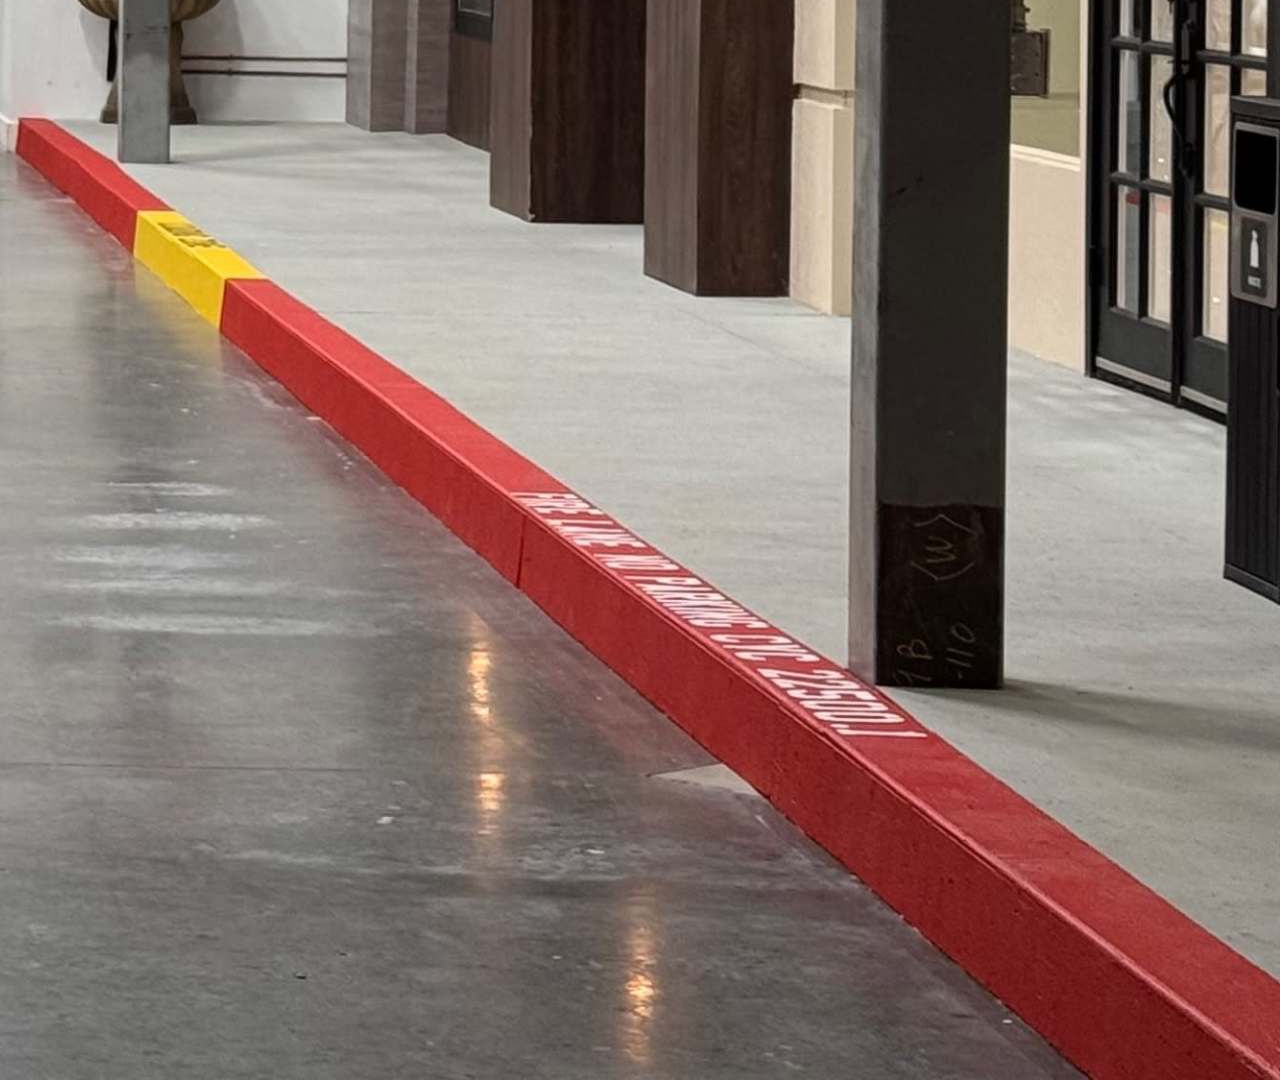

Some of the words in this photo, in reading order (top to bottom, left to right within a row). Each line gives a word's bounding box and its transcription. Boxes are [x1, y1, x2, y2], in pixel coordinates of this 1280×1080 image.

[512, 492, 603, 518] FIRE
[594, 553, 680, 572] NO
[634, 576, 770, 629] PARKING
[757, 667, 928, 739] 22500.1
